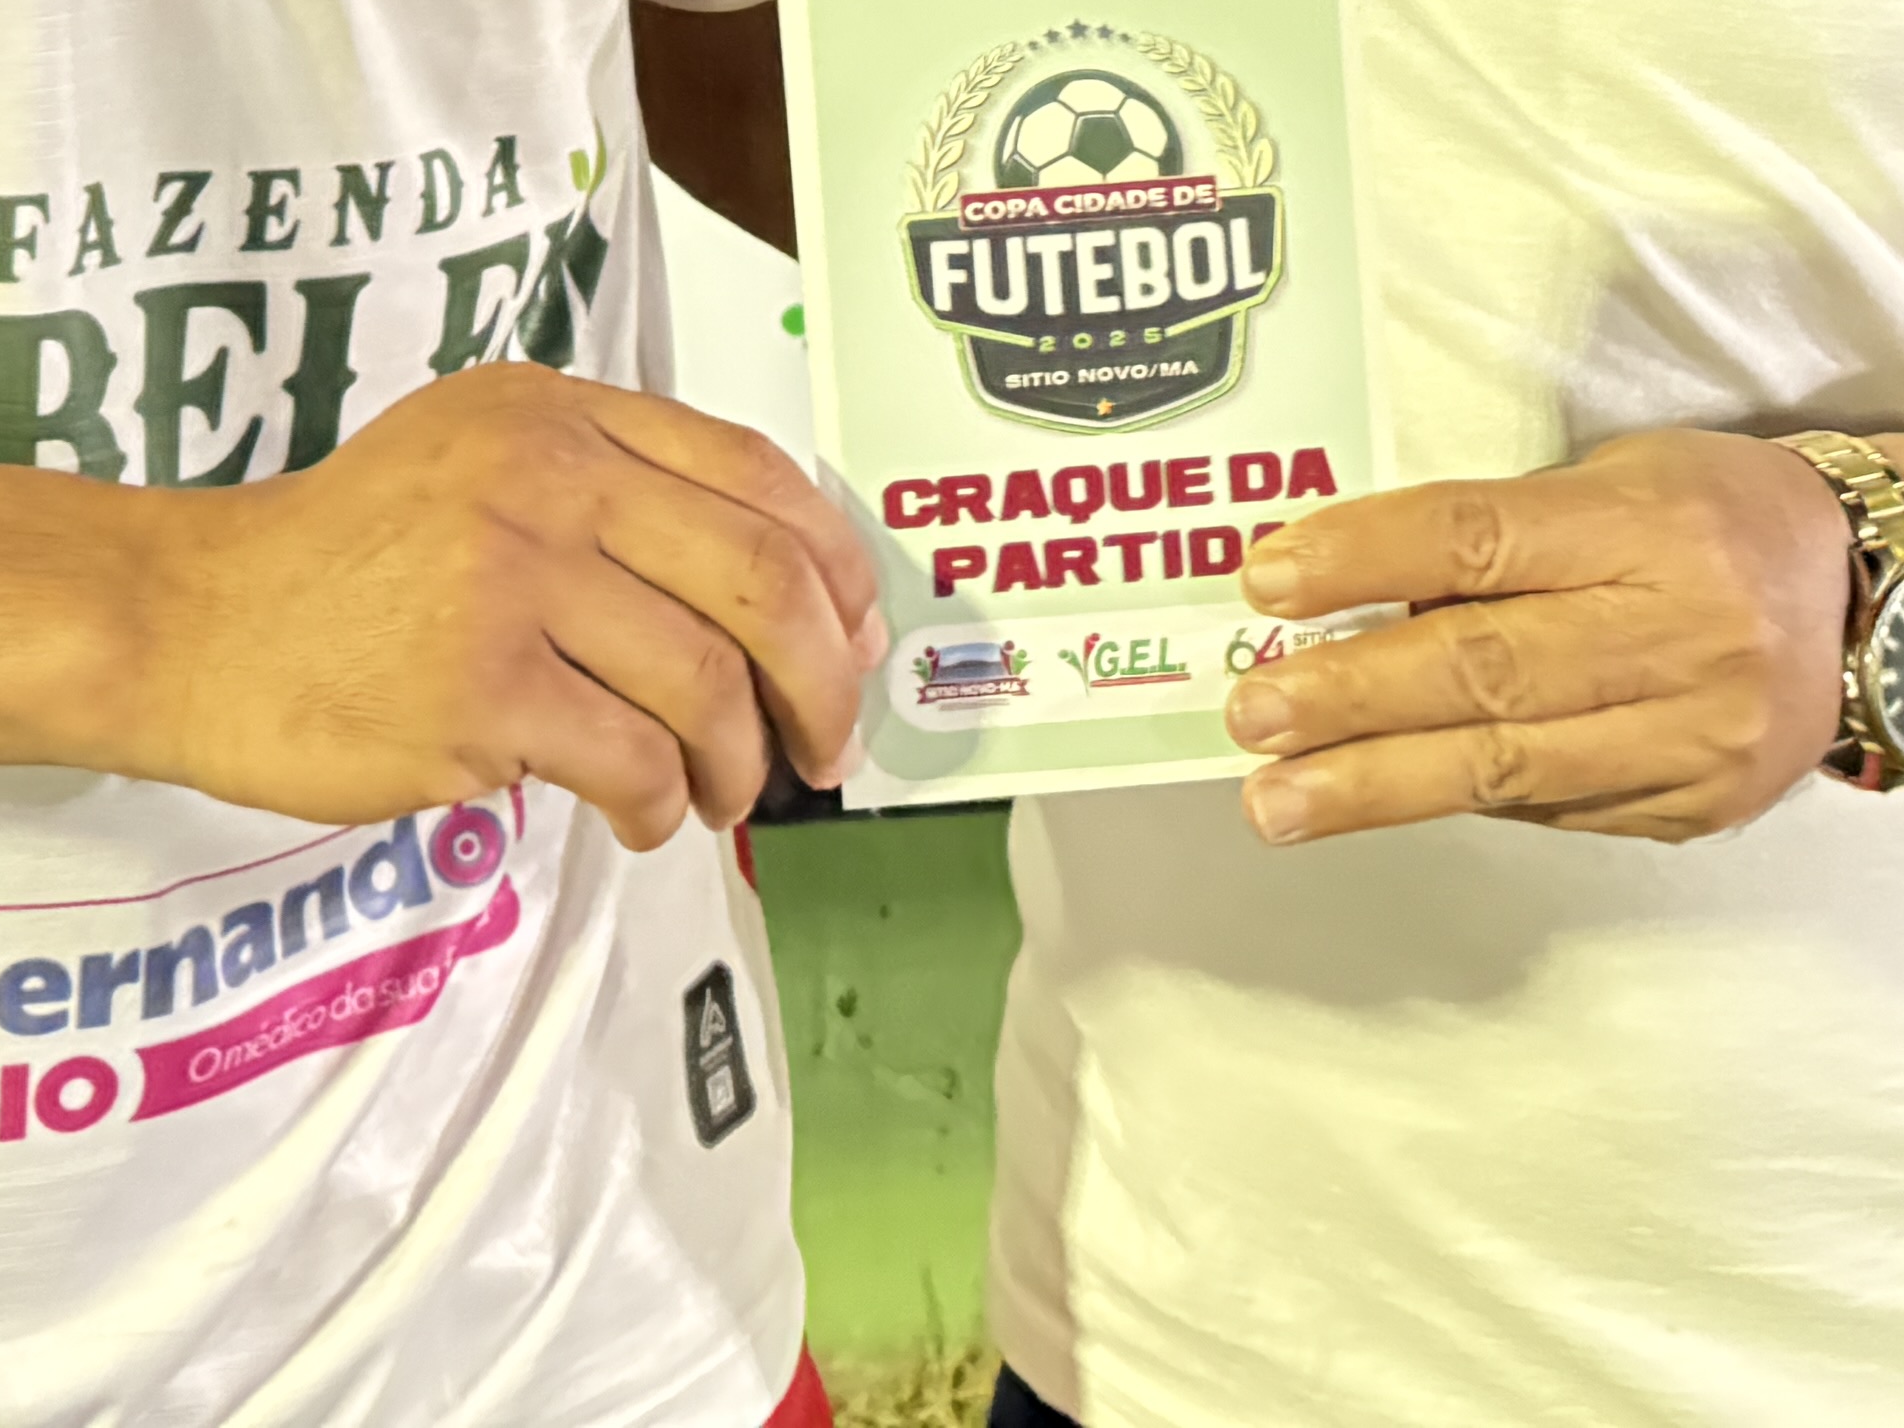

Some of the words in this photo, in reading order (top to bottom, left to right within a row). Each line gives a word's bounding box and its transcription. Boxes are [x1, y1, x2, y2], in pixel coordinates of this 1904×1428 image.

[963, 192, 1048, 223] COPA
[1053, 186, 1168, 218] CIDADE
[1172, 181, 1217, 208] DE
[930, 216, 1269, 320] FUTEBOL
[1004, 367, 1071, 389] SITIO
[1077, 359, 1201, 385] NOVO/MA
[882, 455, 1216, 531] CRAQUE
[1228, 446, 1340, 503] DA
[1094, 636, 1187, 679] G.E.L.
[376, 965, 441, 1008] sua
